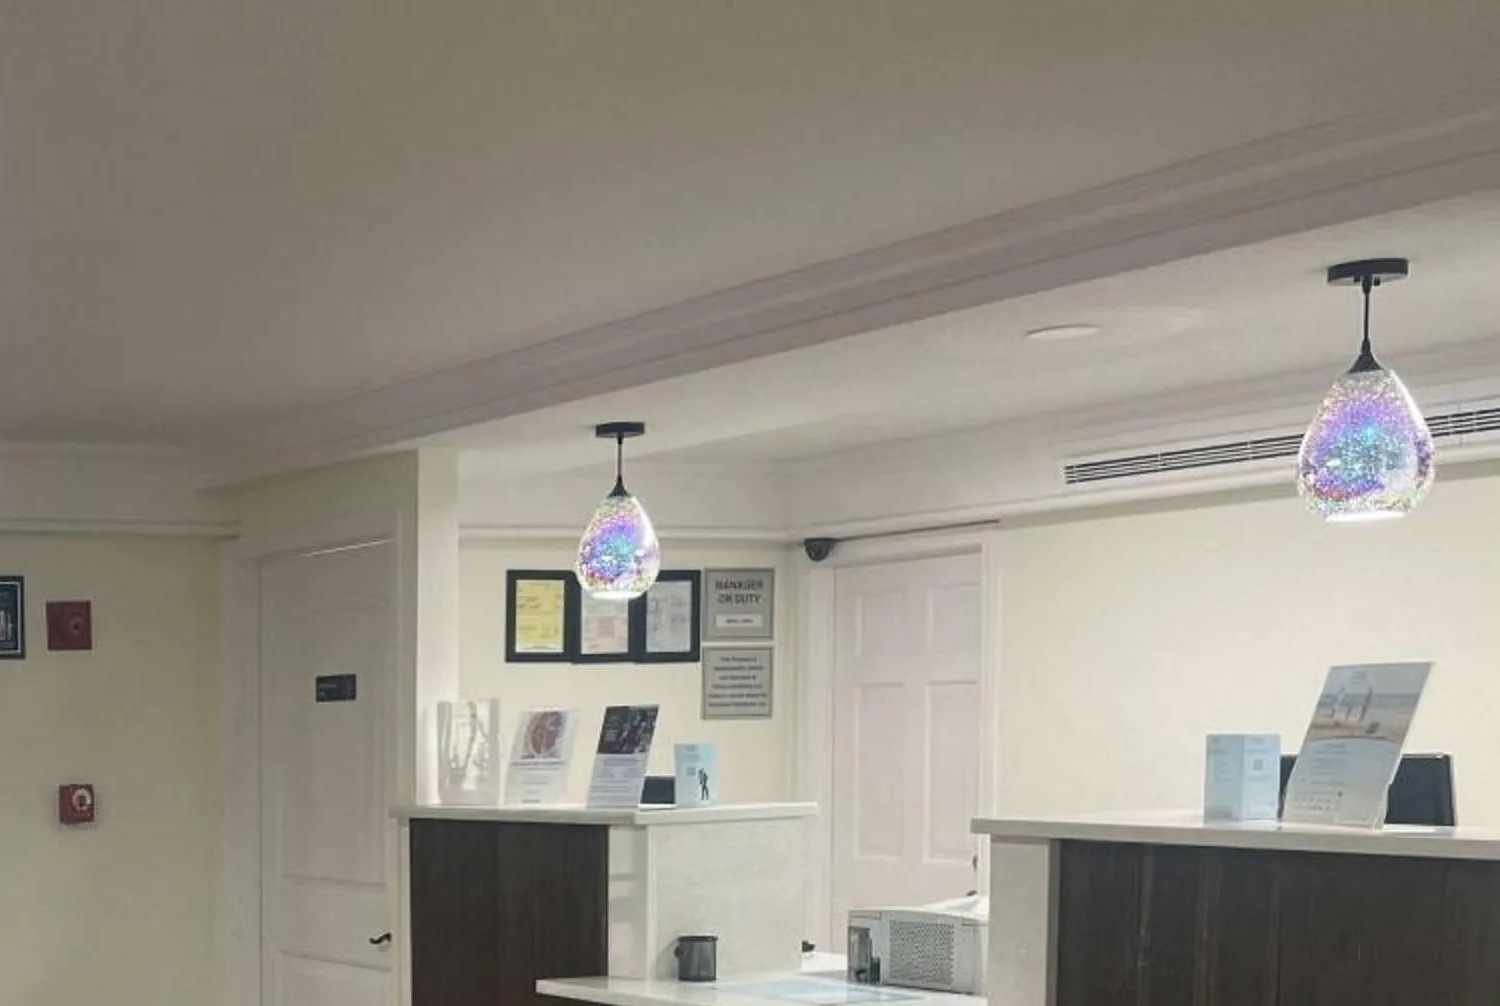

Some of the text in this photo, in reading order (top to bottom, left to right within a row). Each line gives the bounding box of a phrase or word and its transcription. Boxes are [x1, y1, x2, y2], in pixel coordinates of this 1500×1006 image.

[715, 579, 764, 591] MANAGER
[717, 593, 761, 604] ON DUTY
